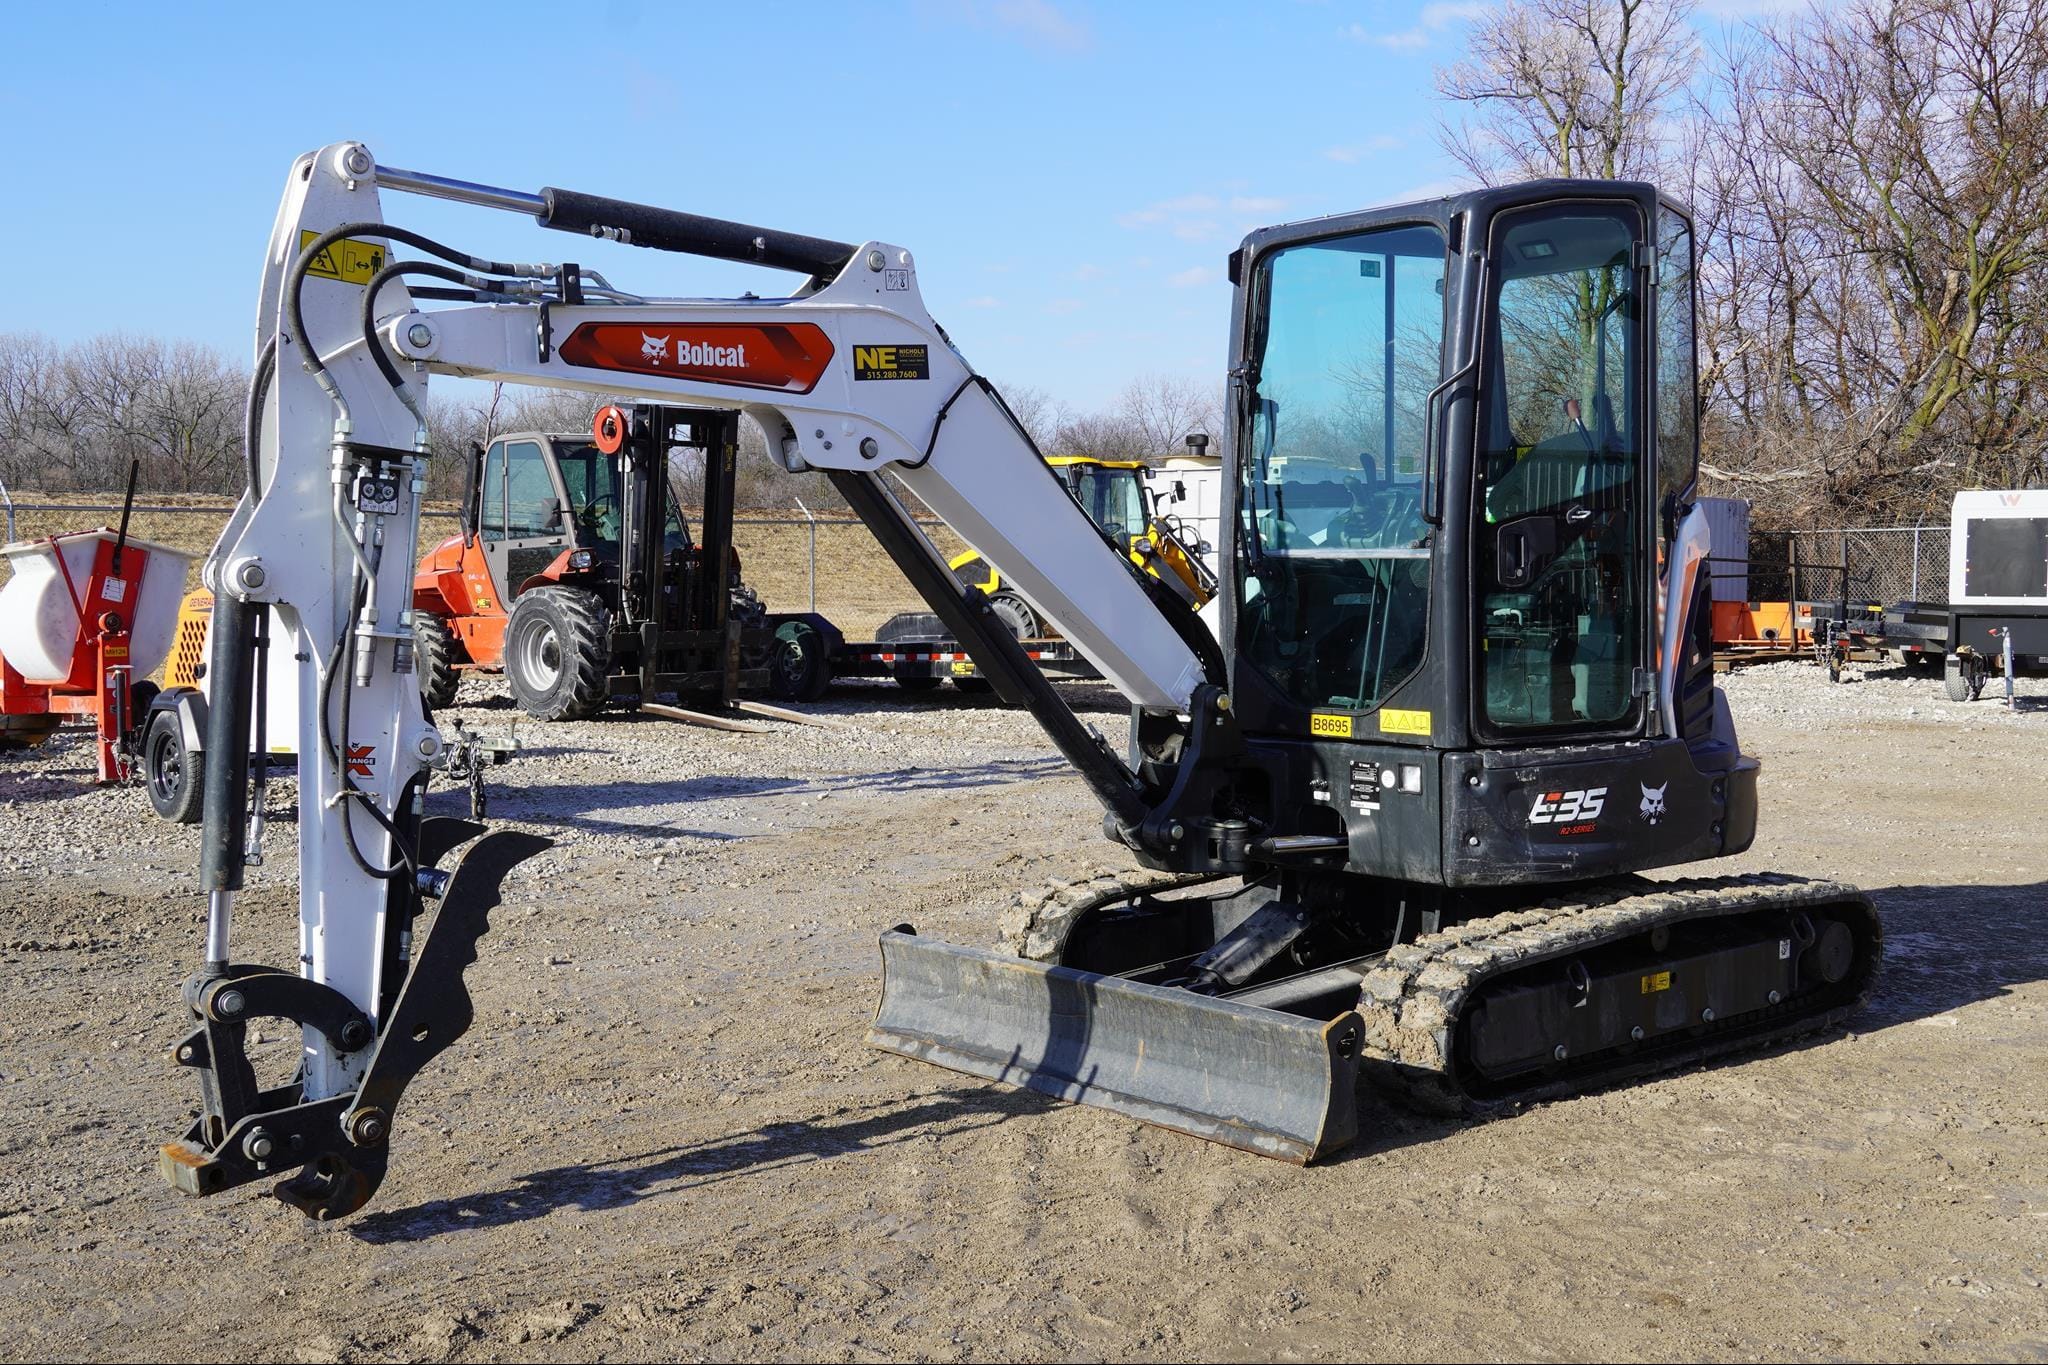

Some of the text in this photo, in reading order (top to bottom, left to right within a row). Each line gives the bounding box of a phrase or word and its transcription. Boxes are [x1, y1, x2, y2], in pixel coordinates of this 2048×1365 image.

[677, 340, 745, 368] Bobcat
[855, 347, 898, 370] NE
[867, 370, 918, 379] 515.280.7600
[1313, 718, 1349, 733] B8695
[1528, 787, 1608, 824] E35
[1560, 822, 1598, 835] R2-SERIES
